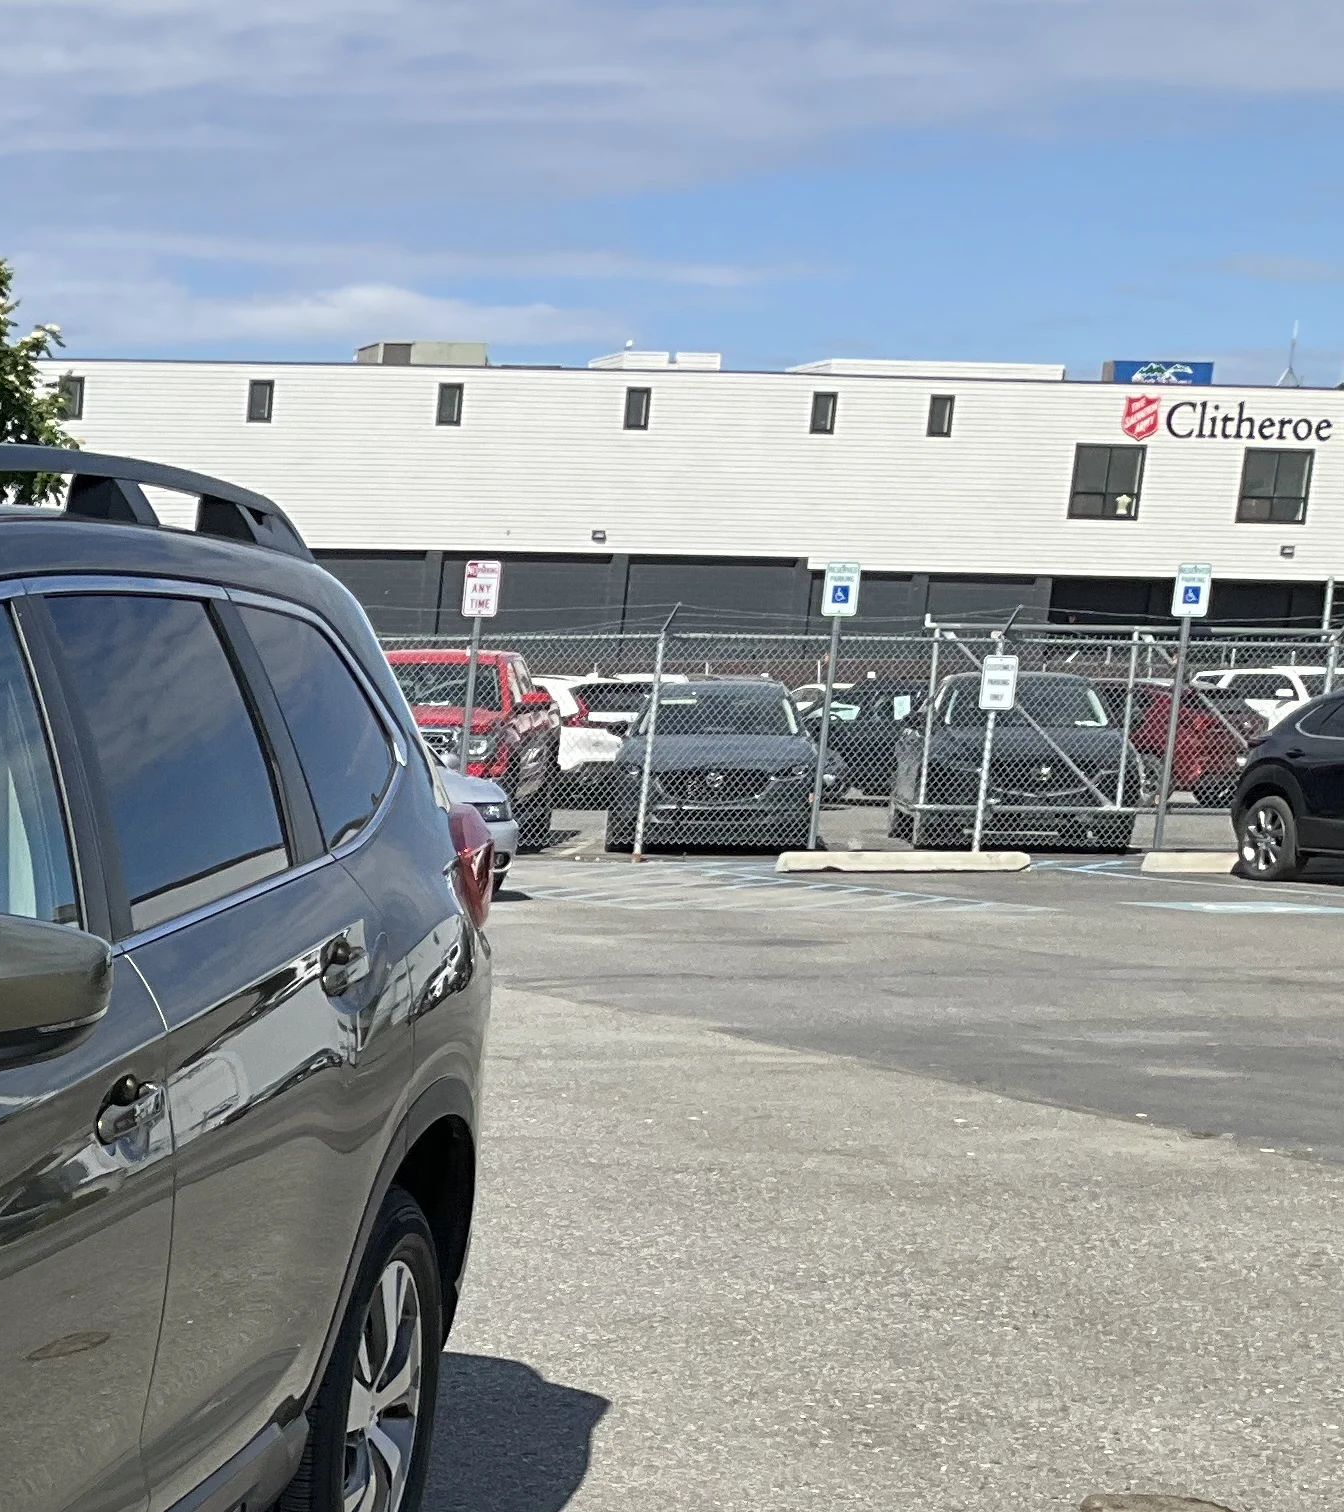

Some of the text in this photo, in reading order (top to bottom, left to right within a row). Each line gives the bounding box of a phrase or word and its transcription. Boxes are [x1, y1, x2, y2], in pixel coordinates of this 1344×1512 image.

[1166, 400, 1332, 441] Clitheroe
[471, 584, 492, 593] ANY
[470, 599, 490, 609] TIME
